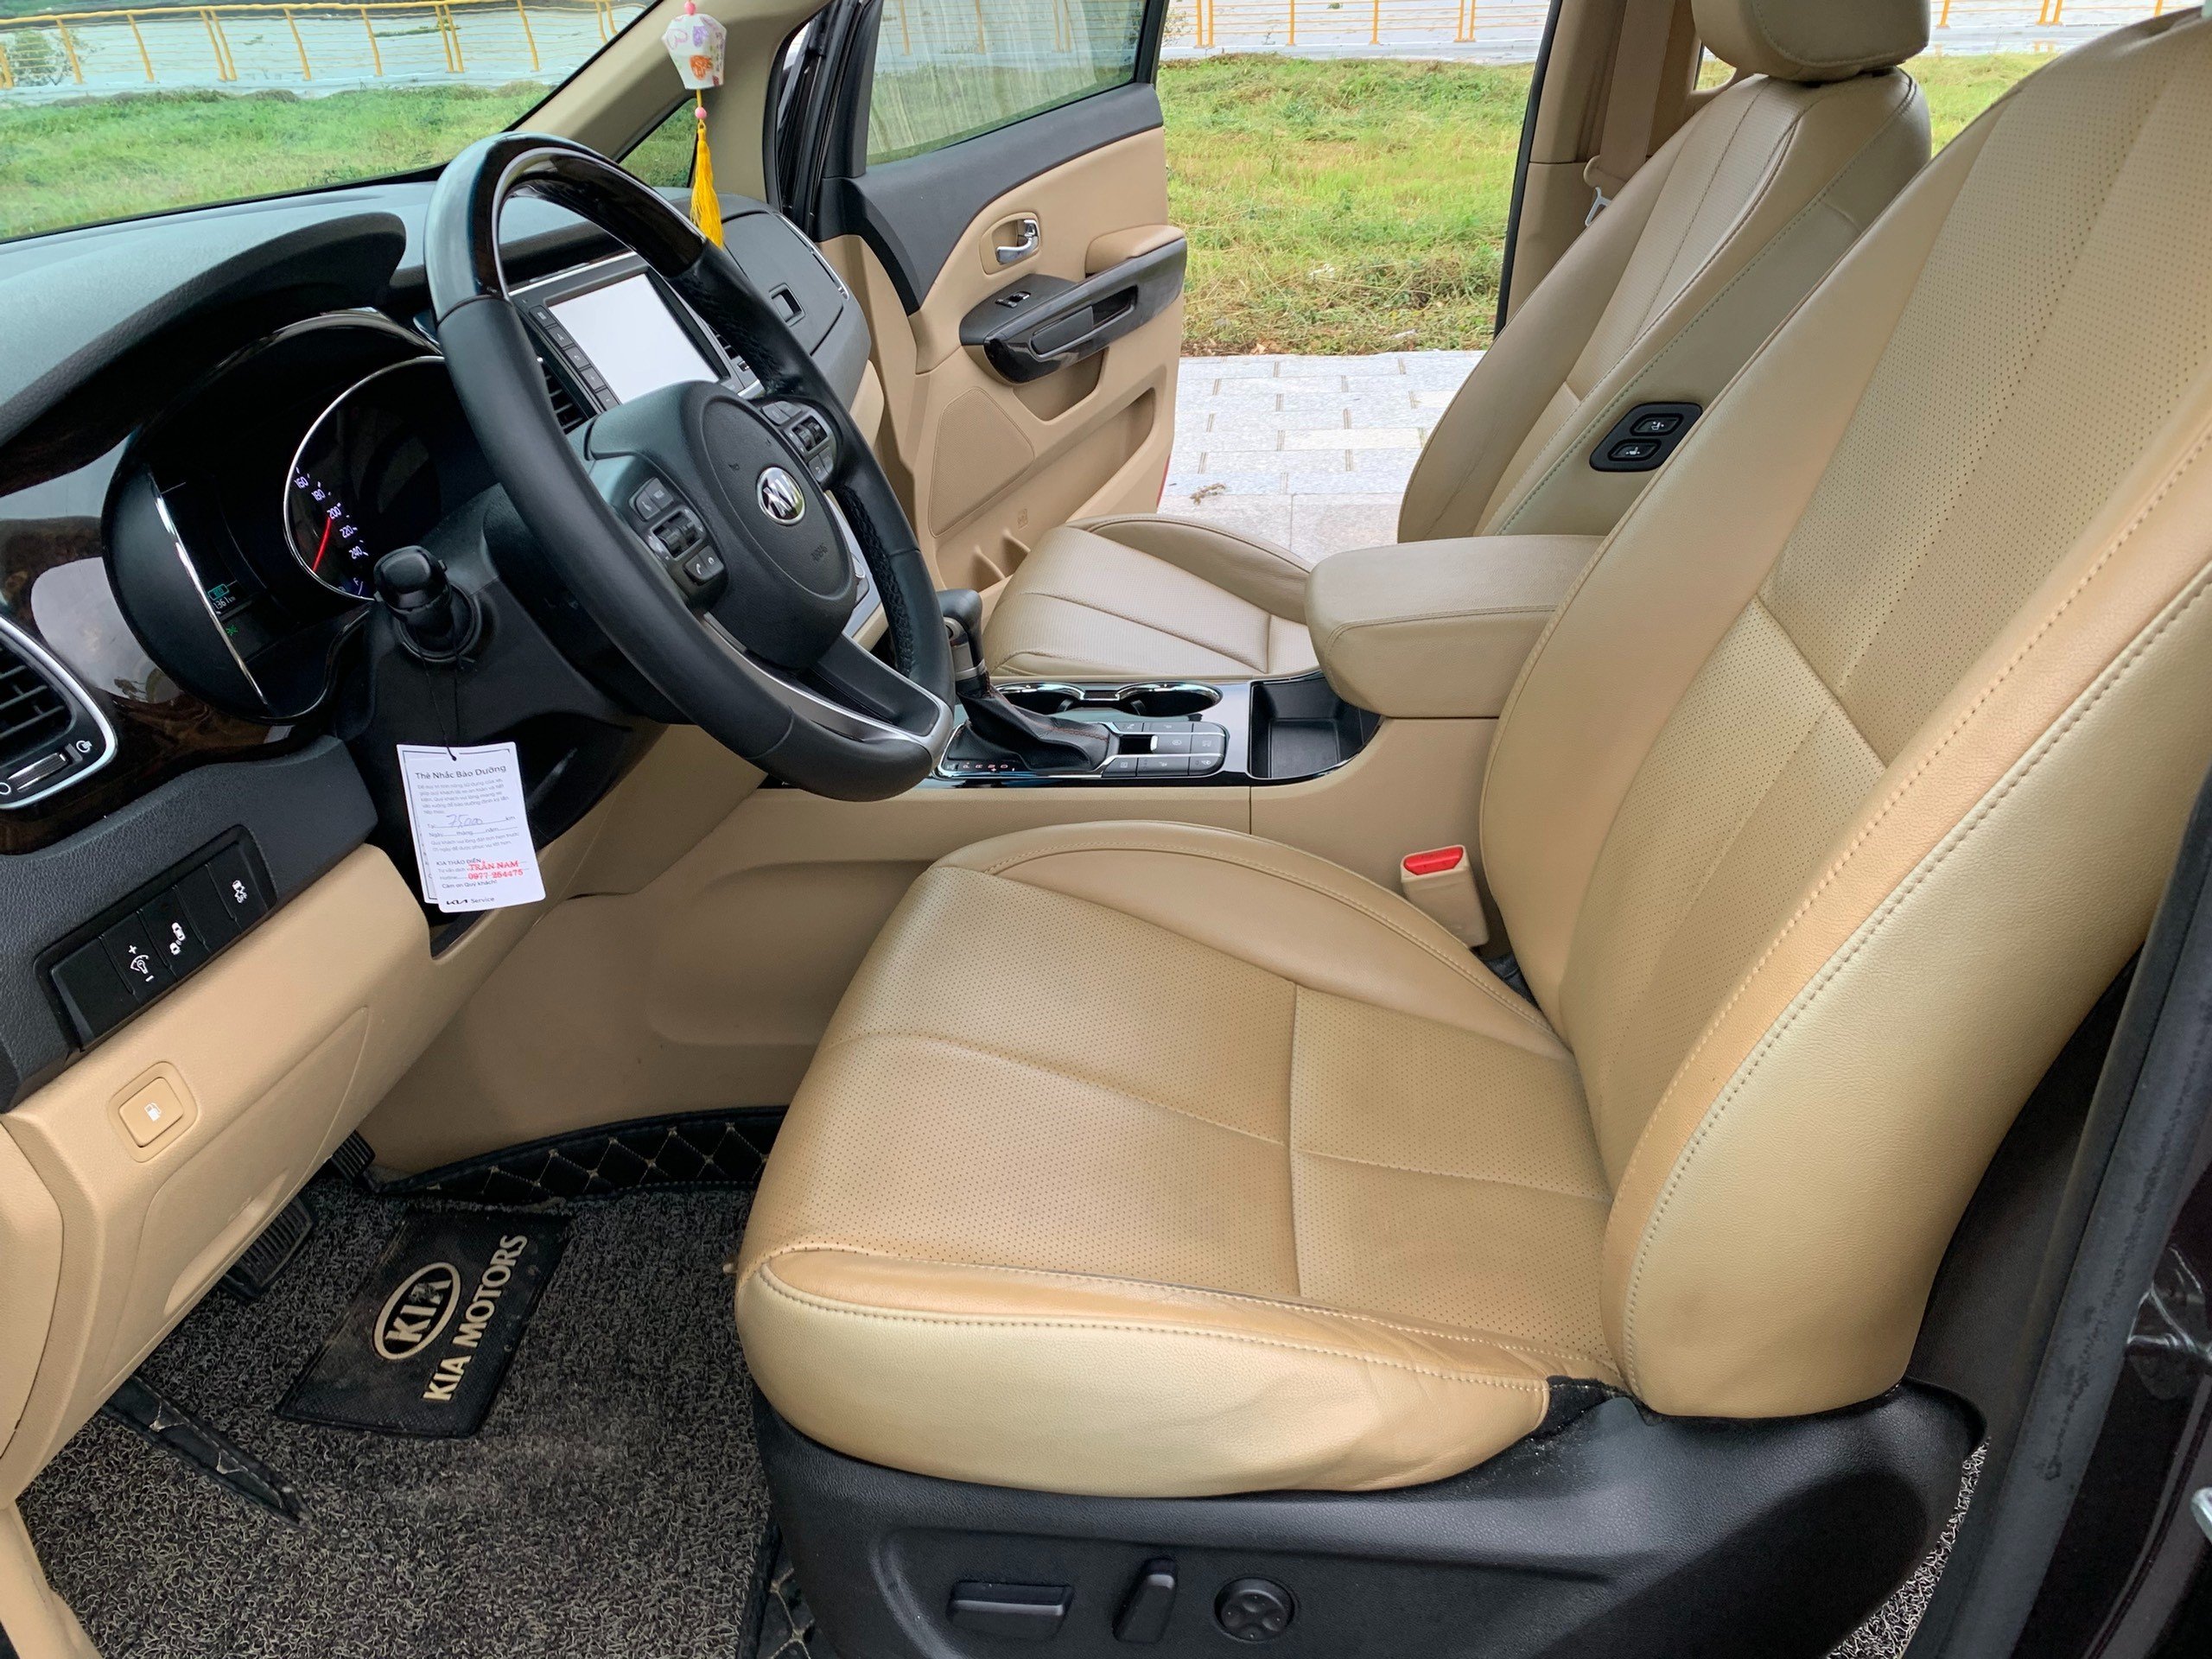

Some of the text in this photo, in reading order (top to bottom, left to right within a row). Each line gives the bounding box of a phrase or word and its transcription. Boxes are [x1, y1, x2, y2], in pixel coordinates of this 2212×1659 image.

[294, 476, 309, 489] 160
[311, 489, 326, 501] 180
[327, 505, 342, 519] 200
[339, 524, 354, 538] 220
[348, 545, 363, 560] 240
[496, 860, 519, 869] NAM
[385, 1279, 453, 1344] KIA
[423, 1235, 529, 1402] KIA MOTORS
